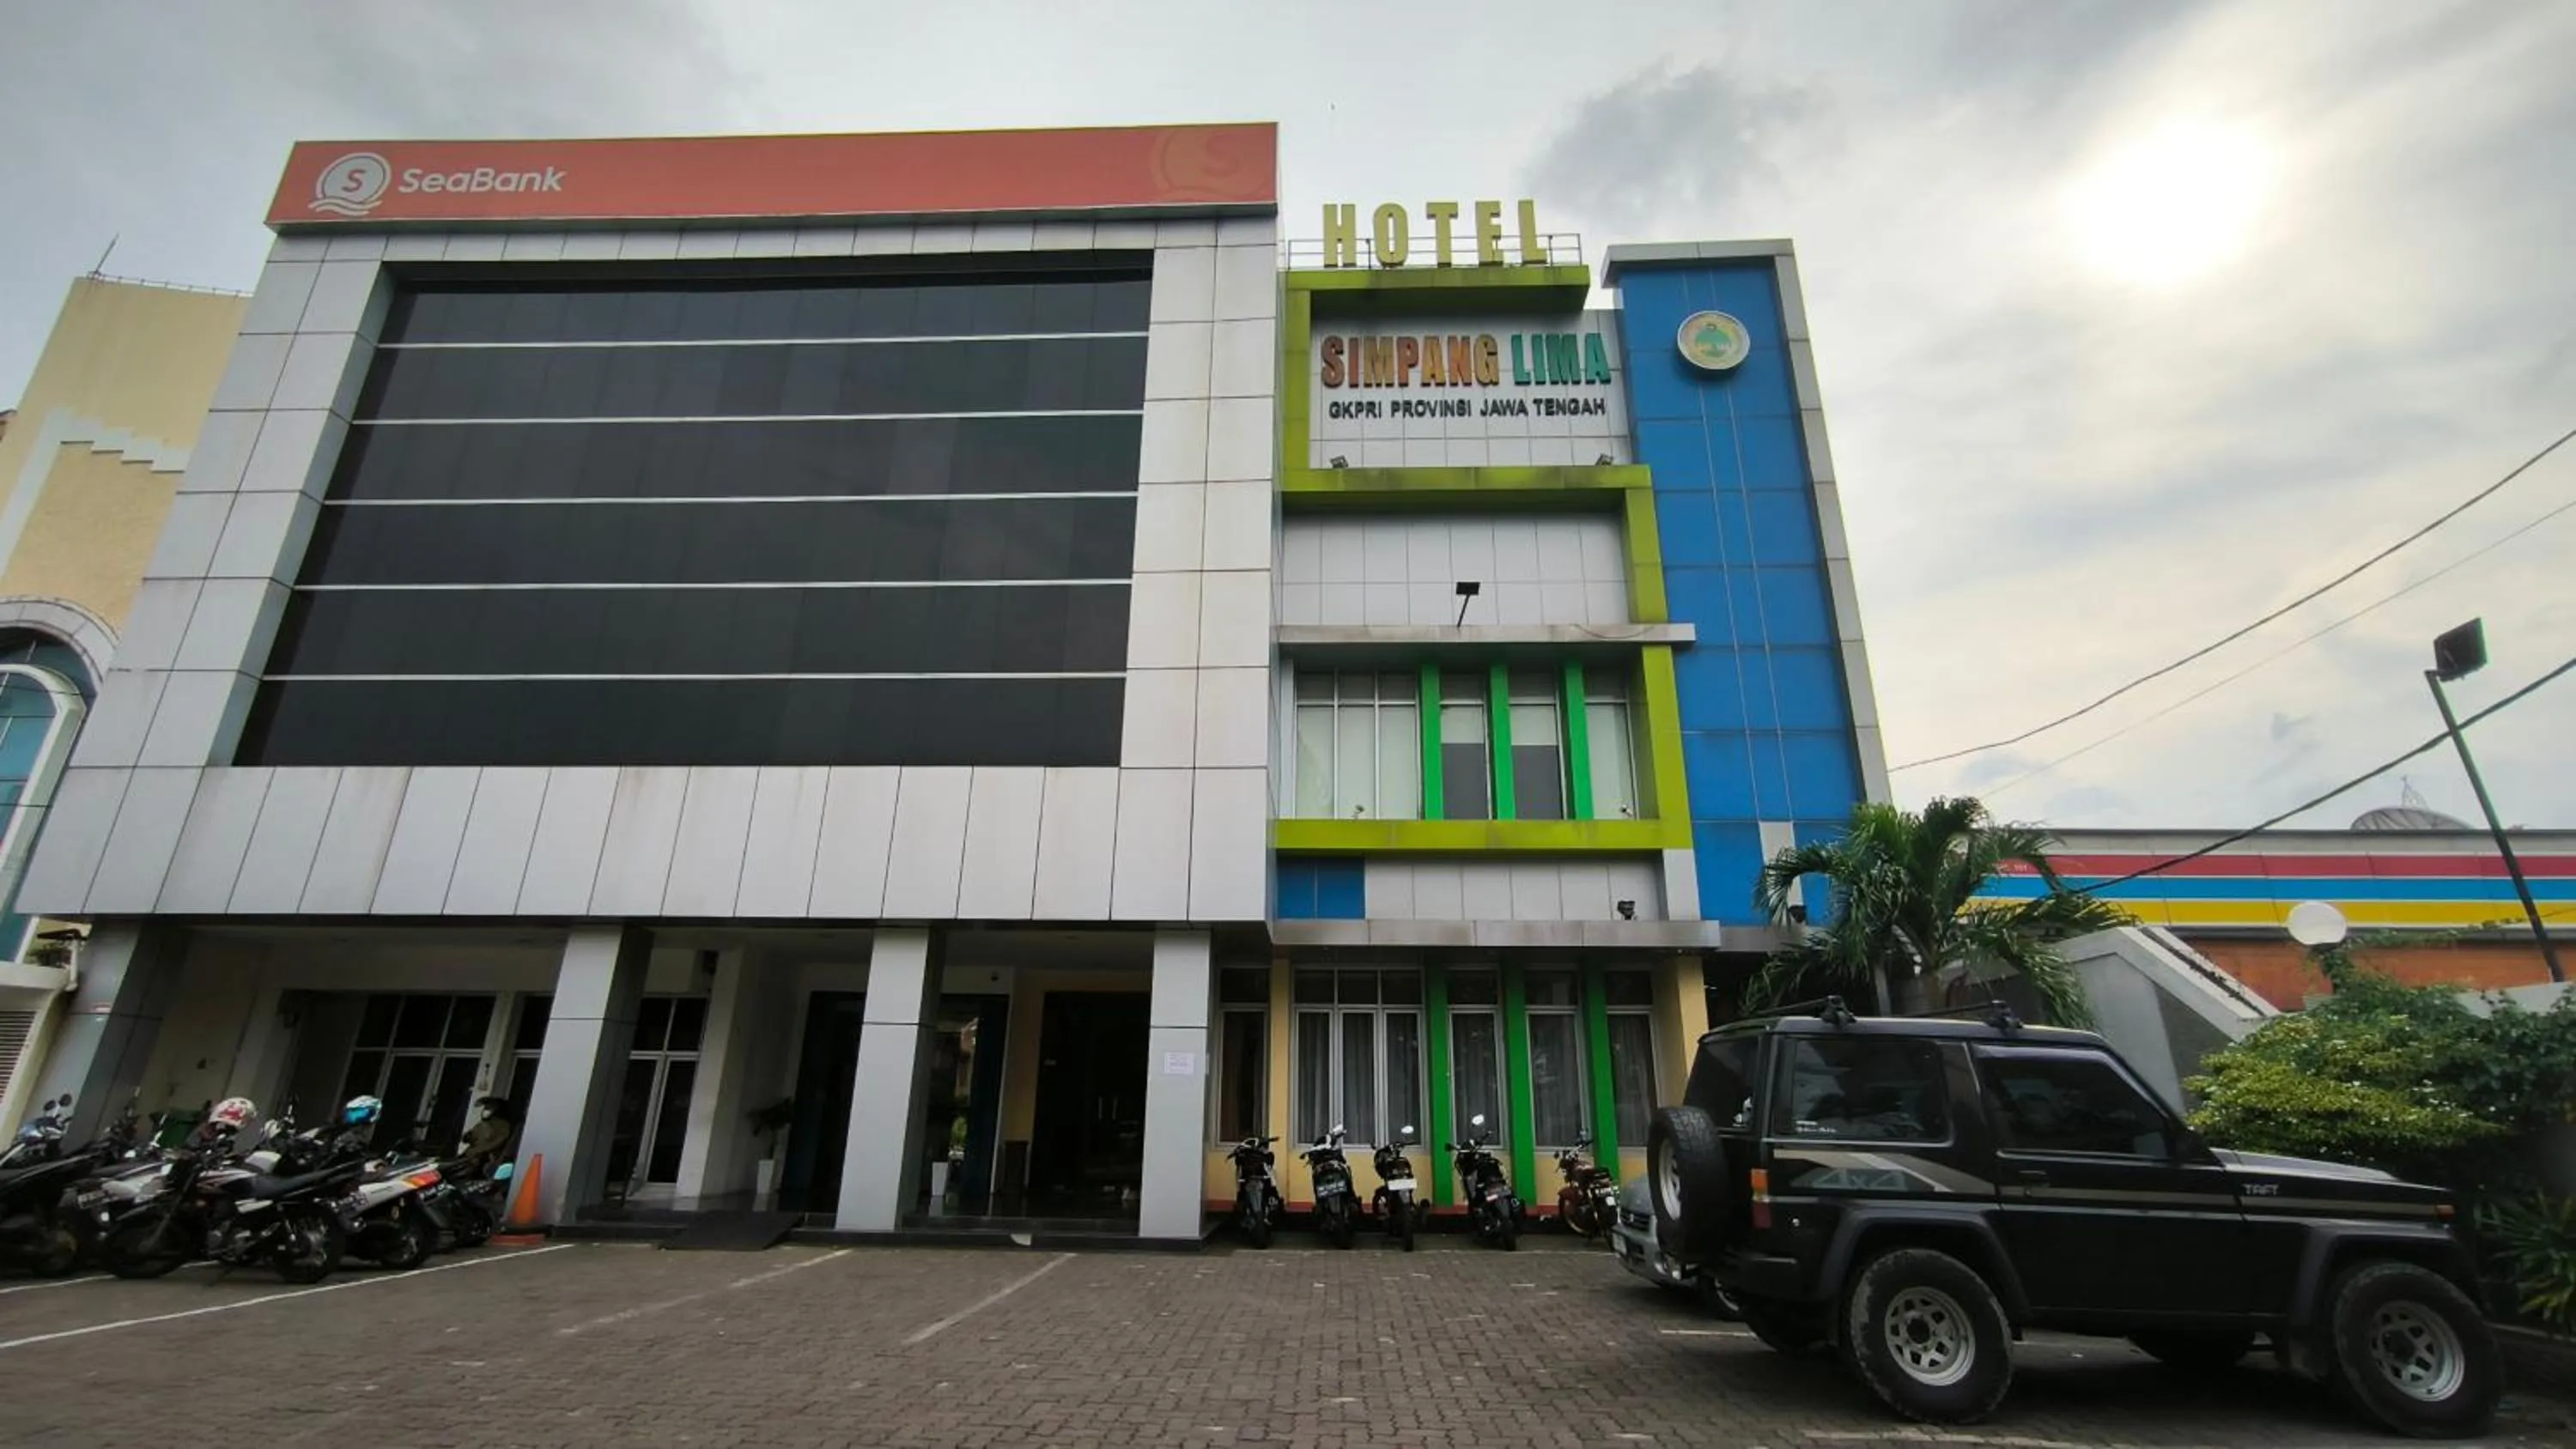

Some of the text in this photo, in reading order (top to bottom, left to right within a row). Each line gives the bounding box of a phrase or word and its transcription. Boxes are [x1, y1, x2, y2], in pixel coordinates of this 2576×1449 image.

[341, 168, 367, 193] S
[398, 166, 567, 194] SeaBank
[1322, 199, 1548, 268] HOTEL
[1321, 332, 1612, 389] SIMPANG LIMA
[1328, 397, 1606, 420] GKPRI PROVINSI JAWA TENGAH
